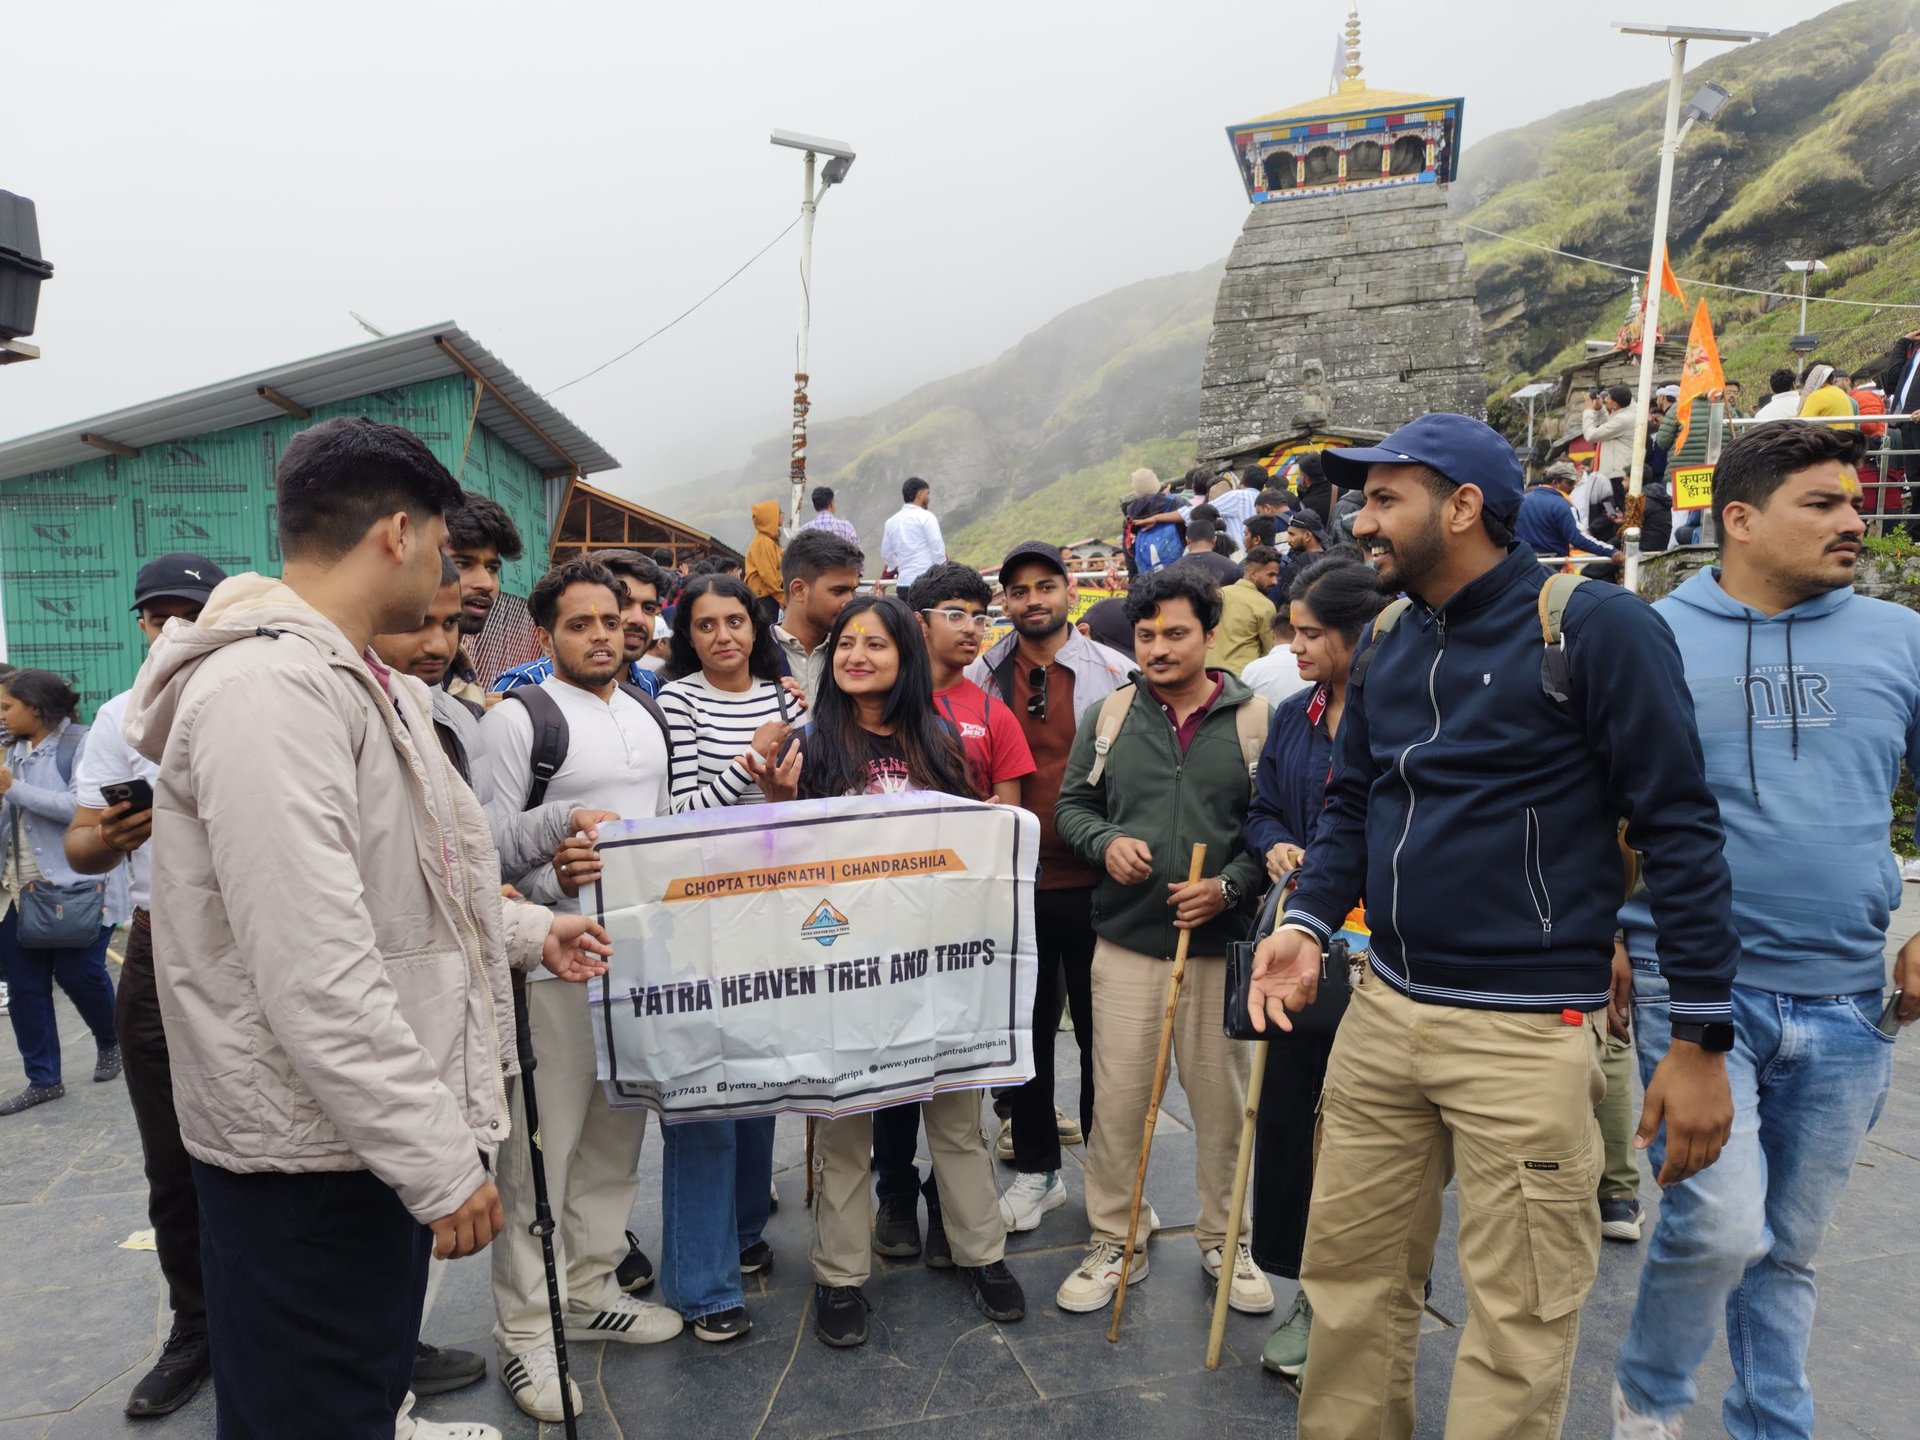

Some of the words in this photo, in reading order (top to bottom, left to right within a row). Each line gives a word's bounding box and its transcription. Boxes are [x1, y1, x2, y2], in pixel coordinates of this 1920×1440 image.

[1680, 473, 1712, 488] कृपया
[65, 616, 110, 632] Jindal
[684, 877, 744, 896] CHOPTA
[747, 867, 826, 888] TUNGNATH
[842, 854, 947, 878] CHANDRASHILA
[629, 978, 713, 1018] YATRA
[720, 965, 816, 1008] HEAVEN
[825, 956, 882, 993] TREK
[889, 948, 929, 984] AND
[934, 938, 996, 973] TRIPS
[679, 1085, 707, 1096] 77433
